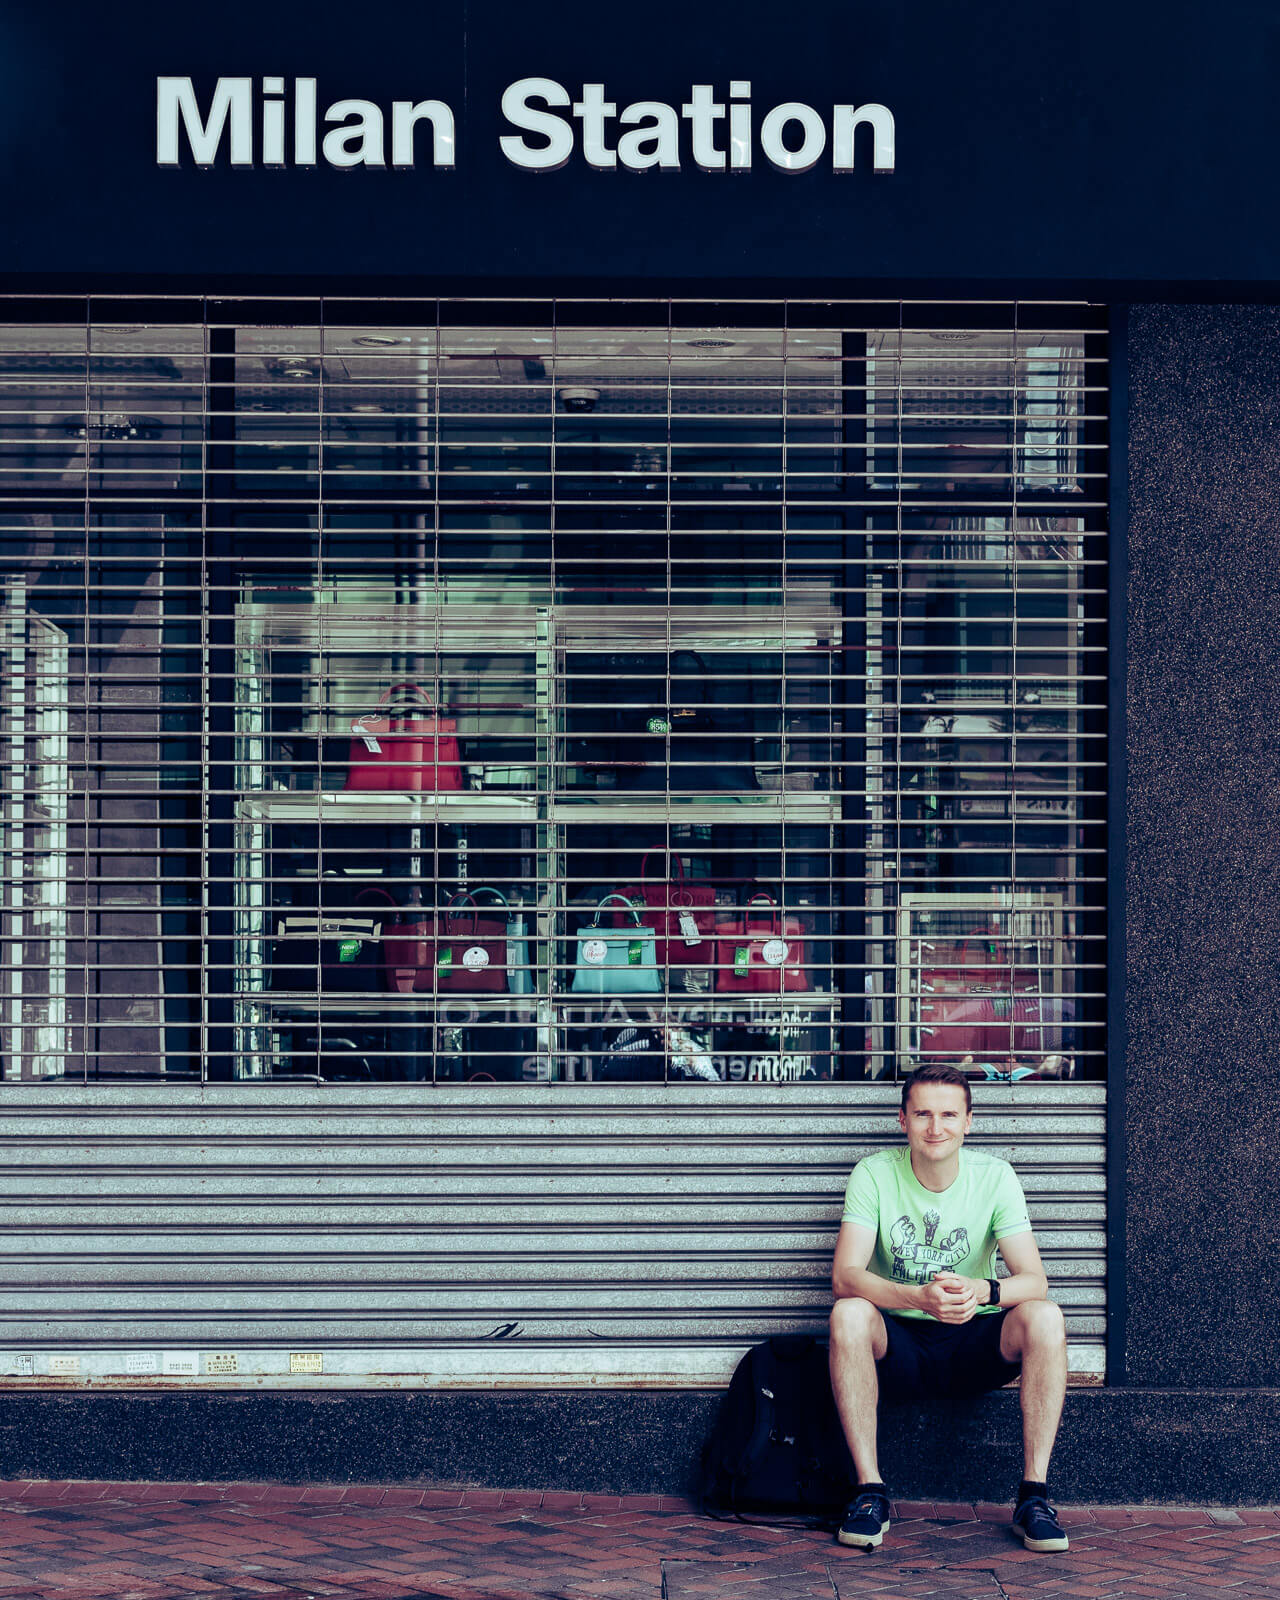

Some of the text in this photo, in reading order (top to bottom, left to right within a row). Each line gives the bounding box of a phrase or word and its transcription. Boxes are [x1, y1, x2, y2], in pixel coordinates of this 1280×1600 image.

[156, 76, 896, 172] Milan Station
[923, 1249, 944, 1262] YORK
[945, 1247, 966, 1263] CITY
